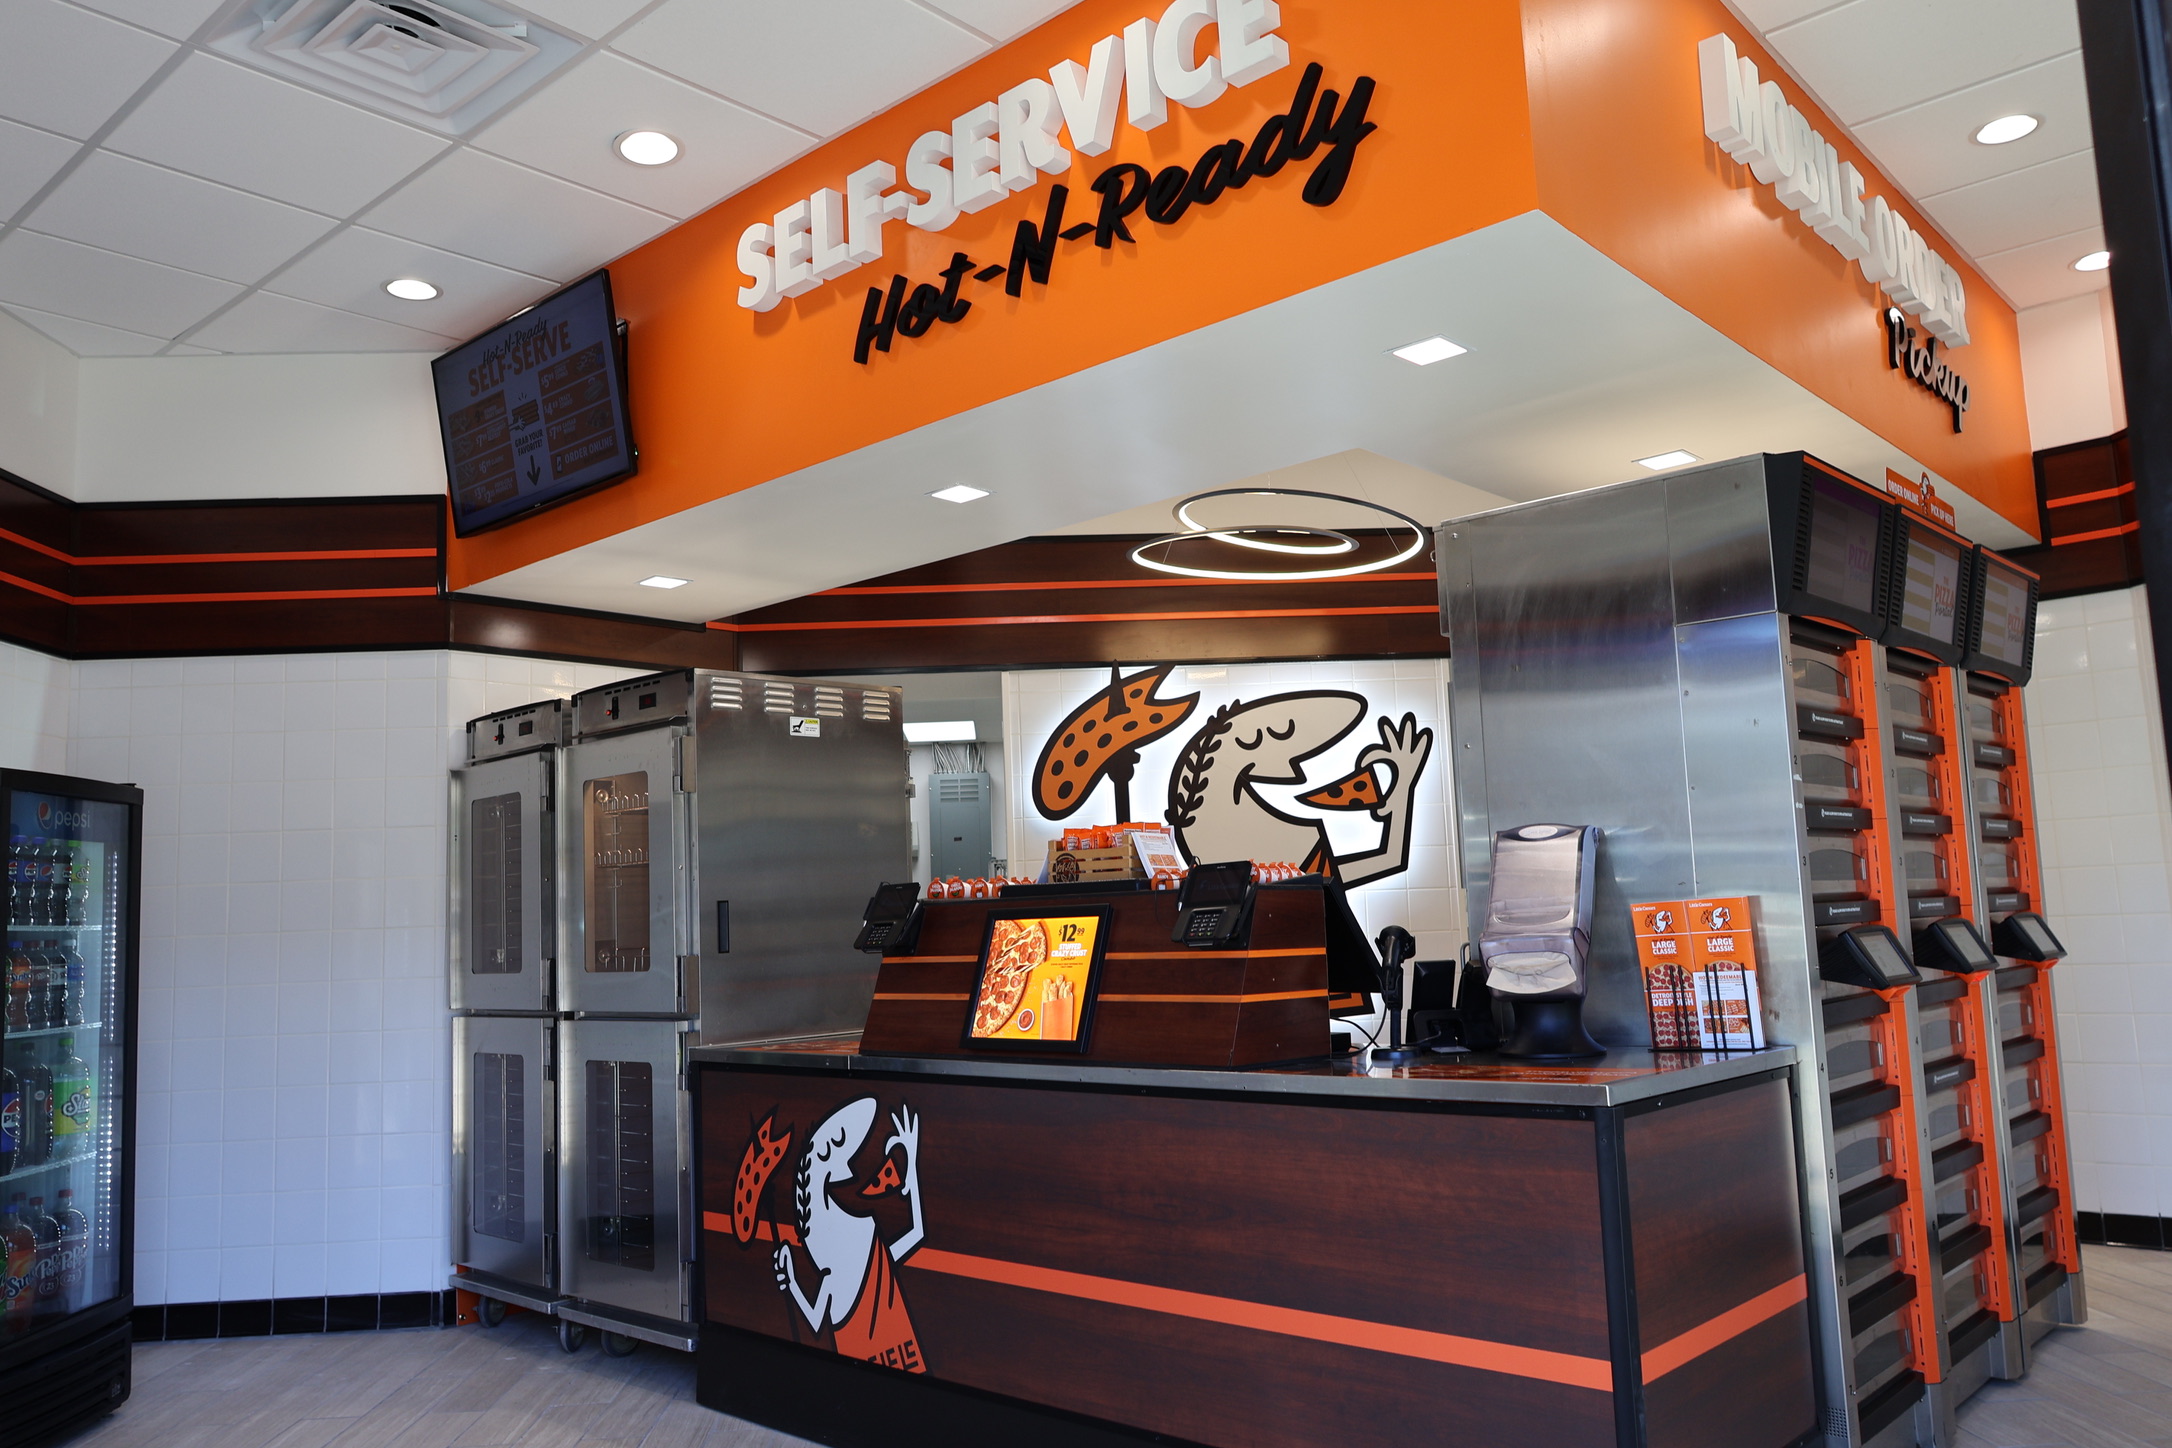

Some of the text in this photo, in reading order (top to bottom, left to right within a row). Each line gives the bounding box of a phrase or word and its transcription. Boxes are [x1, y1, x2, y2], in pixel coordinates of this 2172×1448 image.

[736, 0, 1291, 313] SELF-SERVICE
[1698, 32, 1970, 349] MOBILE ORDER
[853, 62, 1378, 364] Hot-N-Ready
[468, 320, 572, 397] SELF-SERVE
[482, 317, 548, 366] Hot-N-Ready
[1884, 306, 1970, 434] Pickup
[514, 429, 544, 448] GRAB YOUR
[564, 435, 614, 464] ORDER ONLINE
[1888, 480, 1920, 506] ORDER ONLINE
[1930, 504, 1939, 518] PICK
[1944, 512, 1954, 527] HERE
[1934, 583, 1954, 610] PIZZA
[54, 810, 90, 831] pepsi
